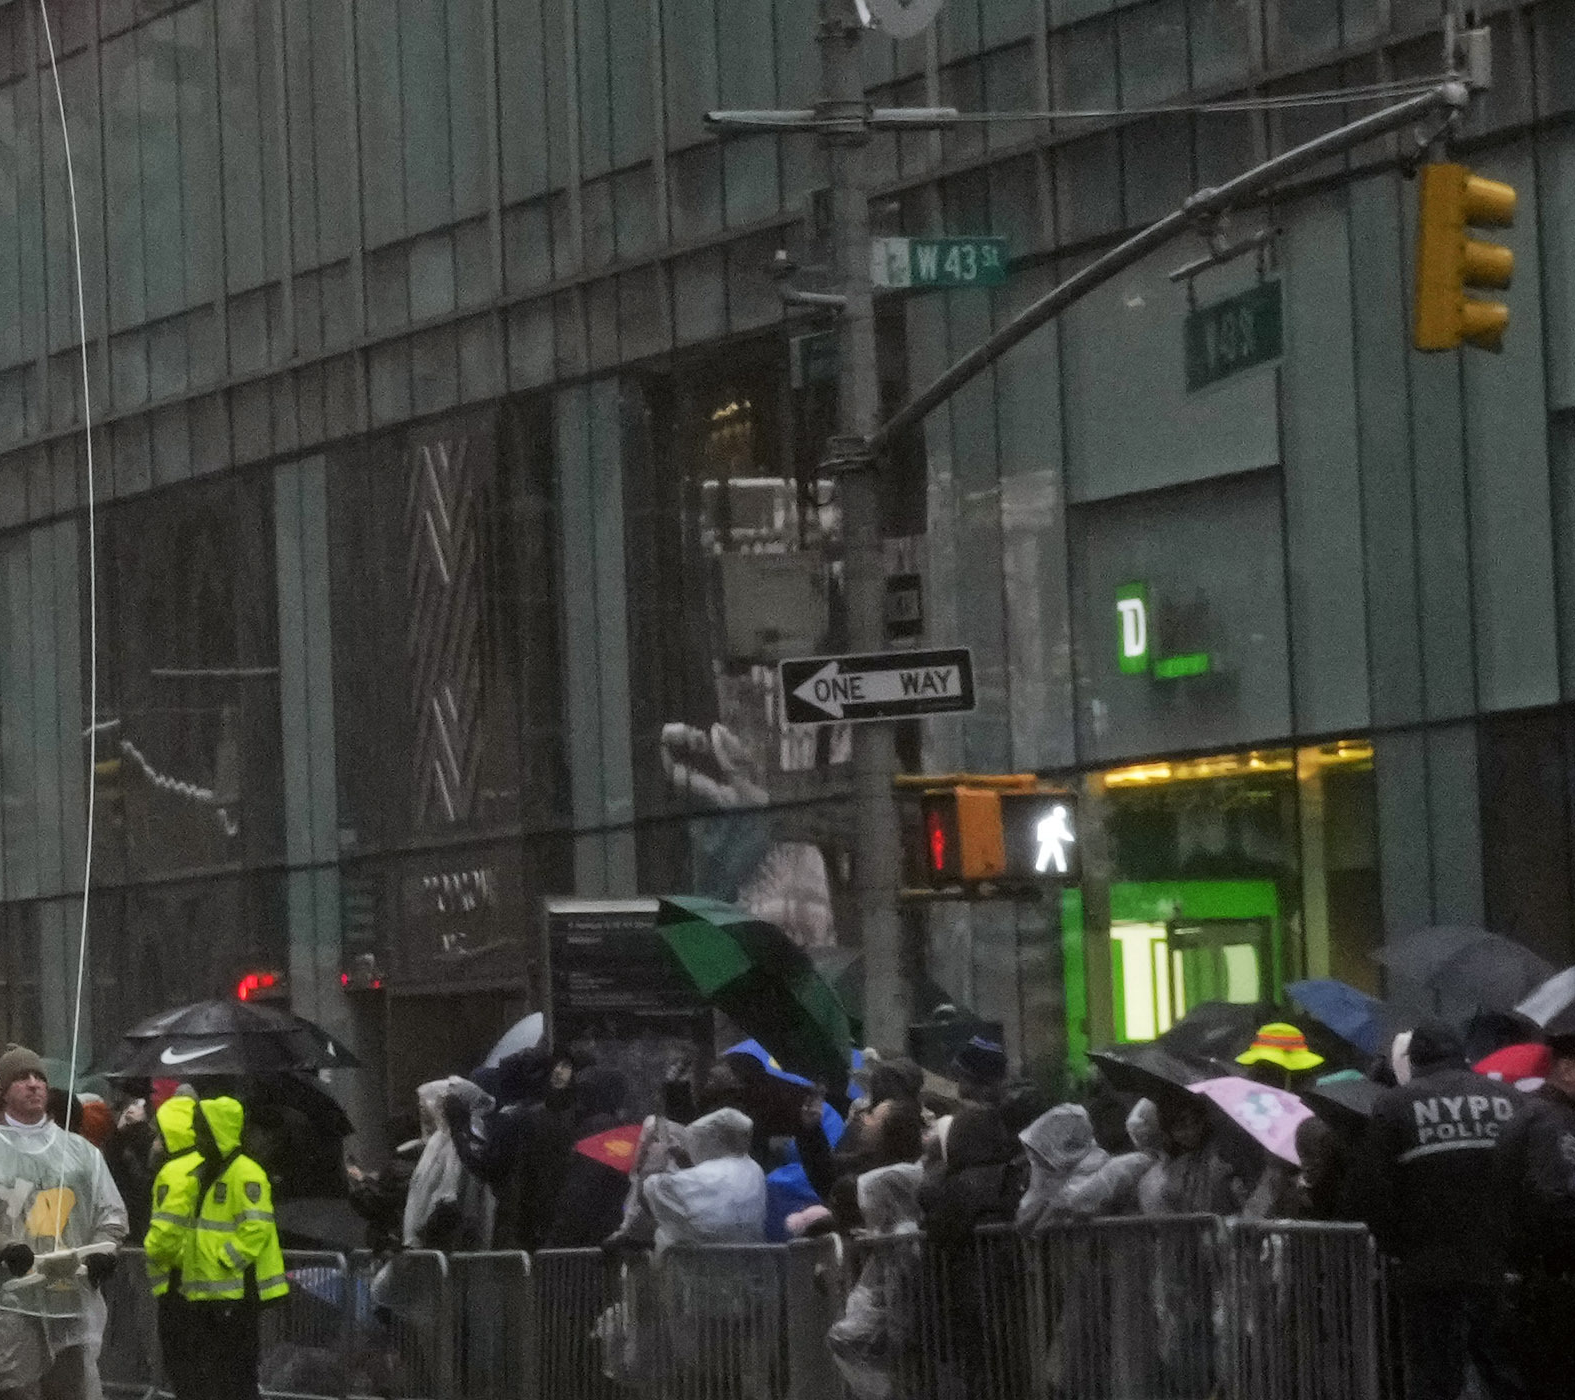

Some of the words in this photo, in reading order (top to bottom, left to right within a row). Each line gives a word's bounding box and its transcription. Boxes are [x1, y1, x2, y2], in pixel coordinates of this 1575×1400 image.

[915, 245, 939, 280] W
[944, 243, 977, 280] 43
[814, 674, 865, 703] ONE
[899, 668, 954, 697] WAY
[1413, 1094, 1515, 1125] NYPD
[1418, 1121, 1501, 1144] POLIC
